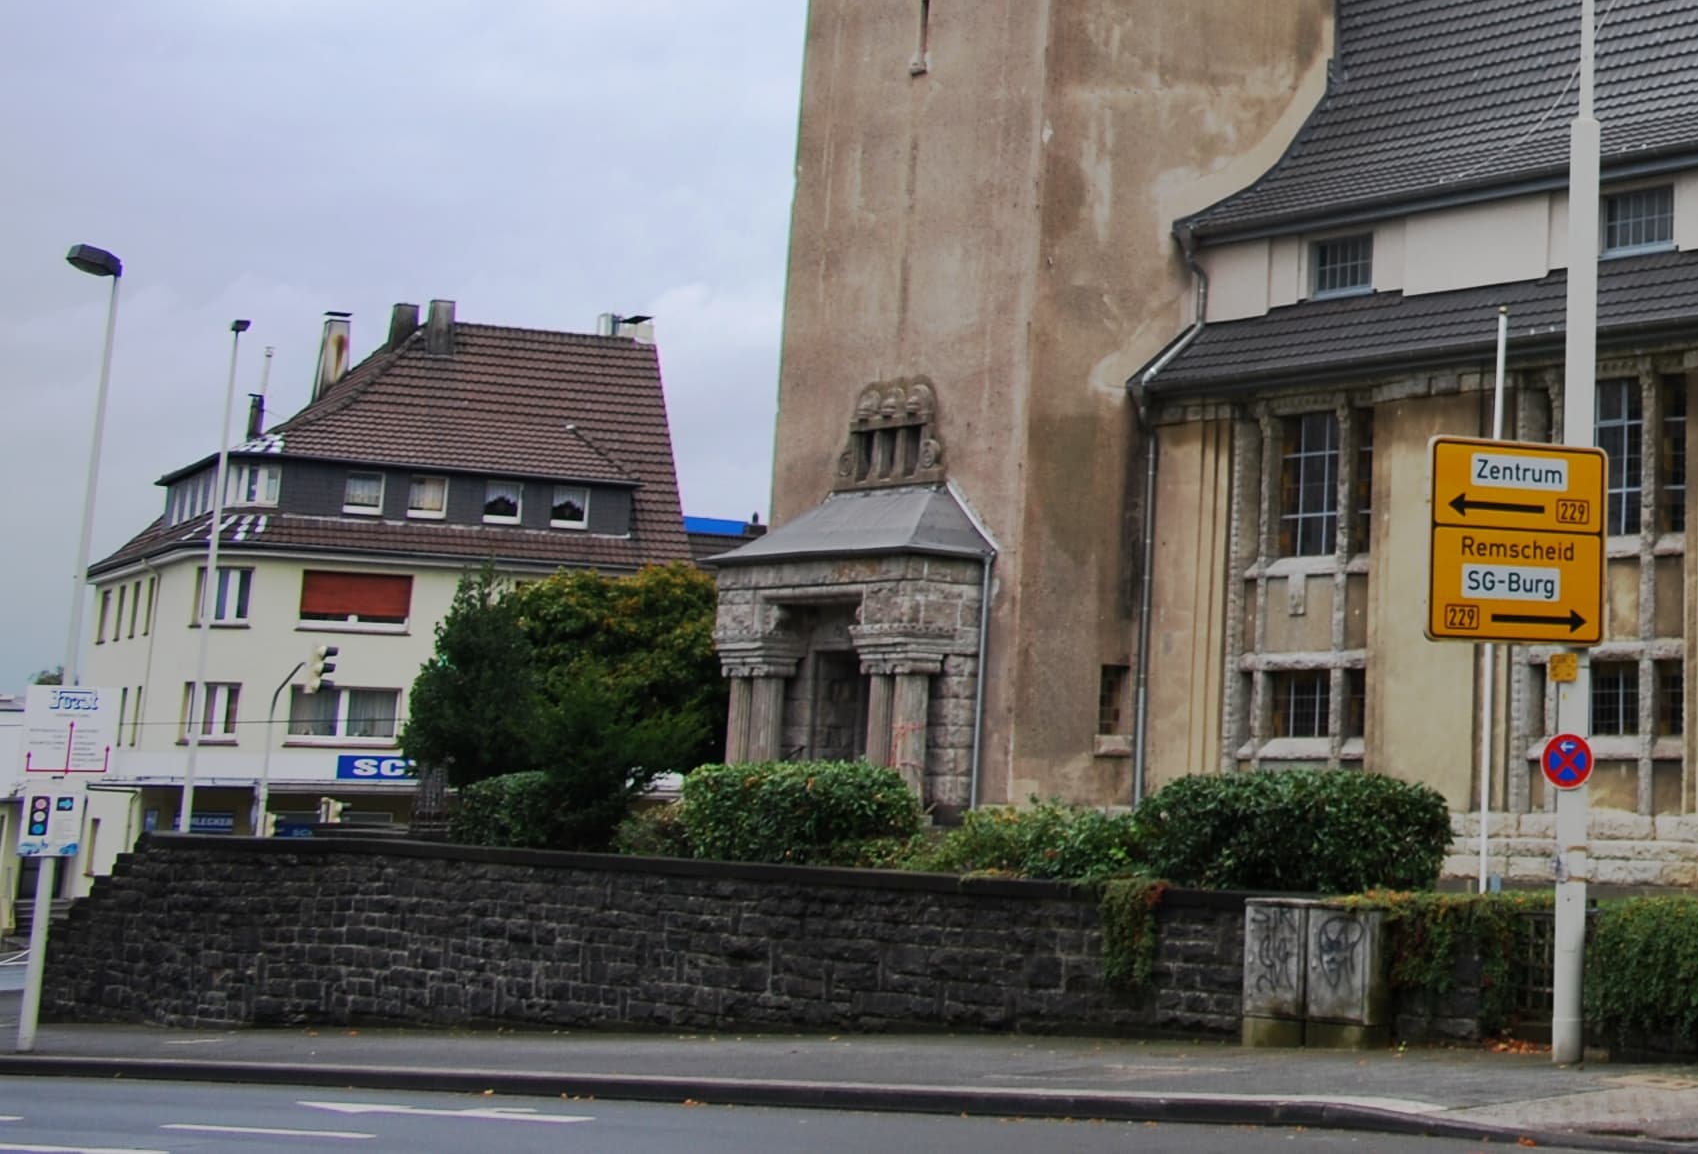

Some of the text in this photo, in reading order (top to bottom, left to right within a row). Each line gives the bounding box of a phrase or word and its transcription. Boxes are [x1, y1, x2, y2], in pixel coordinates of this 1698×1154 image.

[1476, 459, 1562, 484] Zentrum
[1560, 502, 1585, 521] 229
[1461, 536, 1575, 562] Remscheid
[1467, 570, 1555, 599] SG-Burg
[1449, 608, 1475, 627] 229
